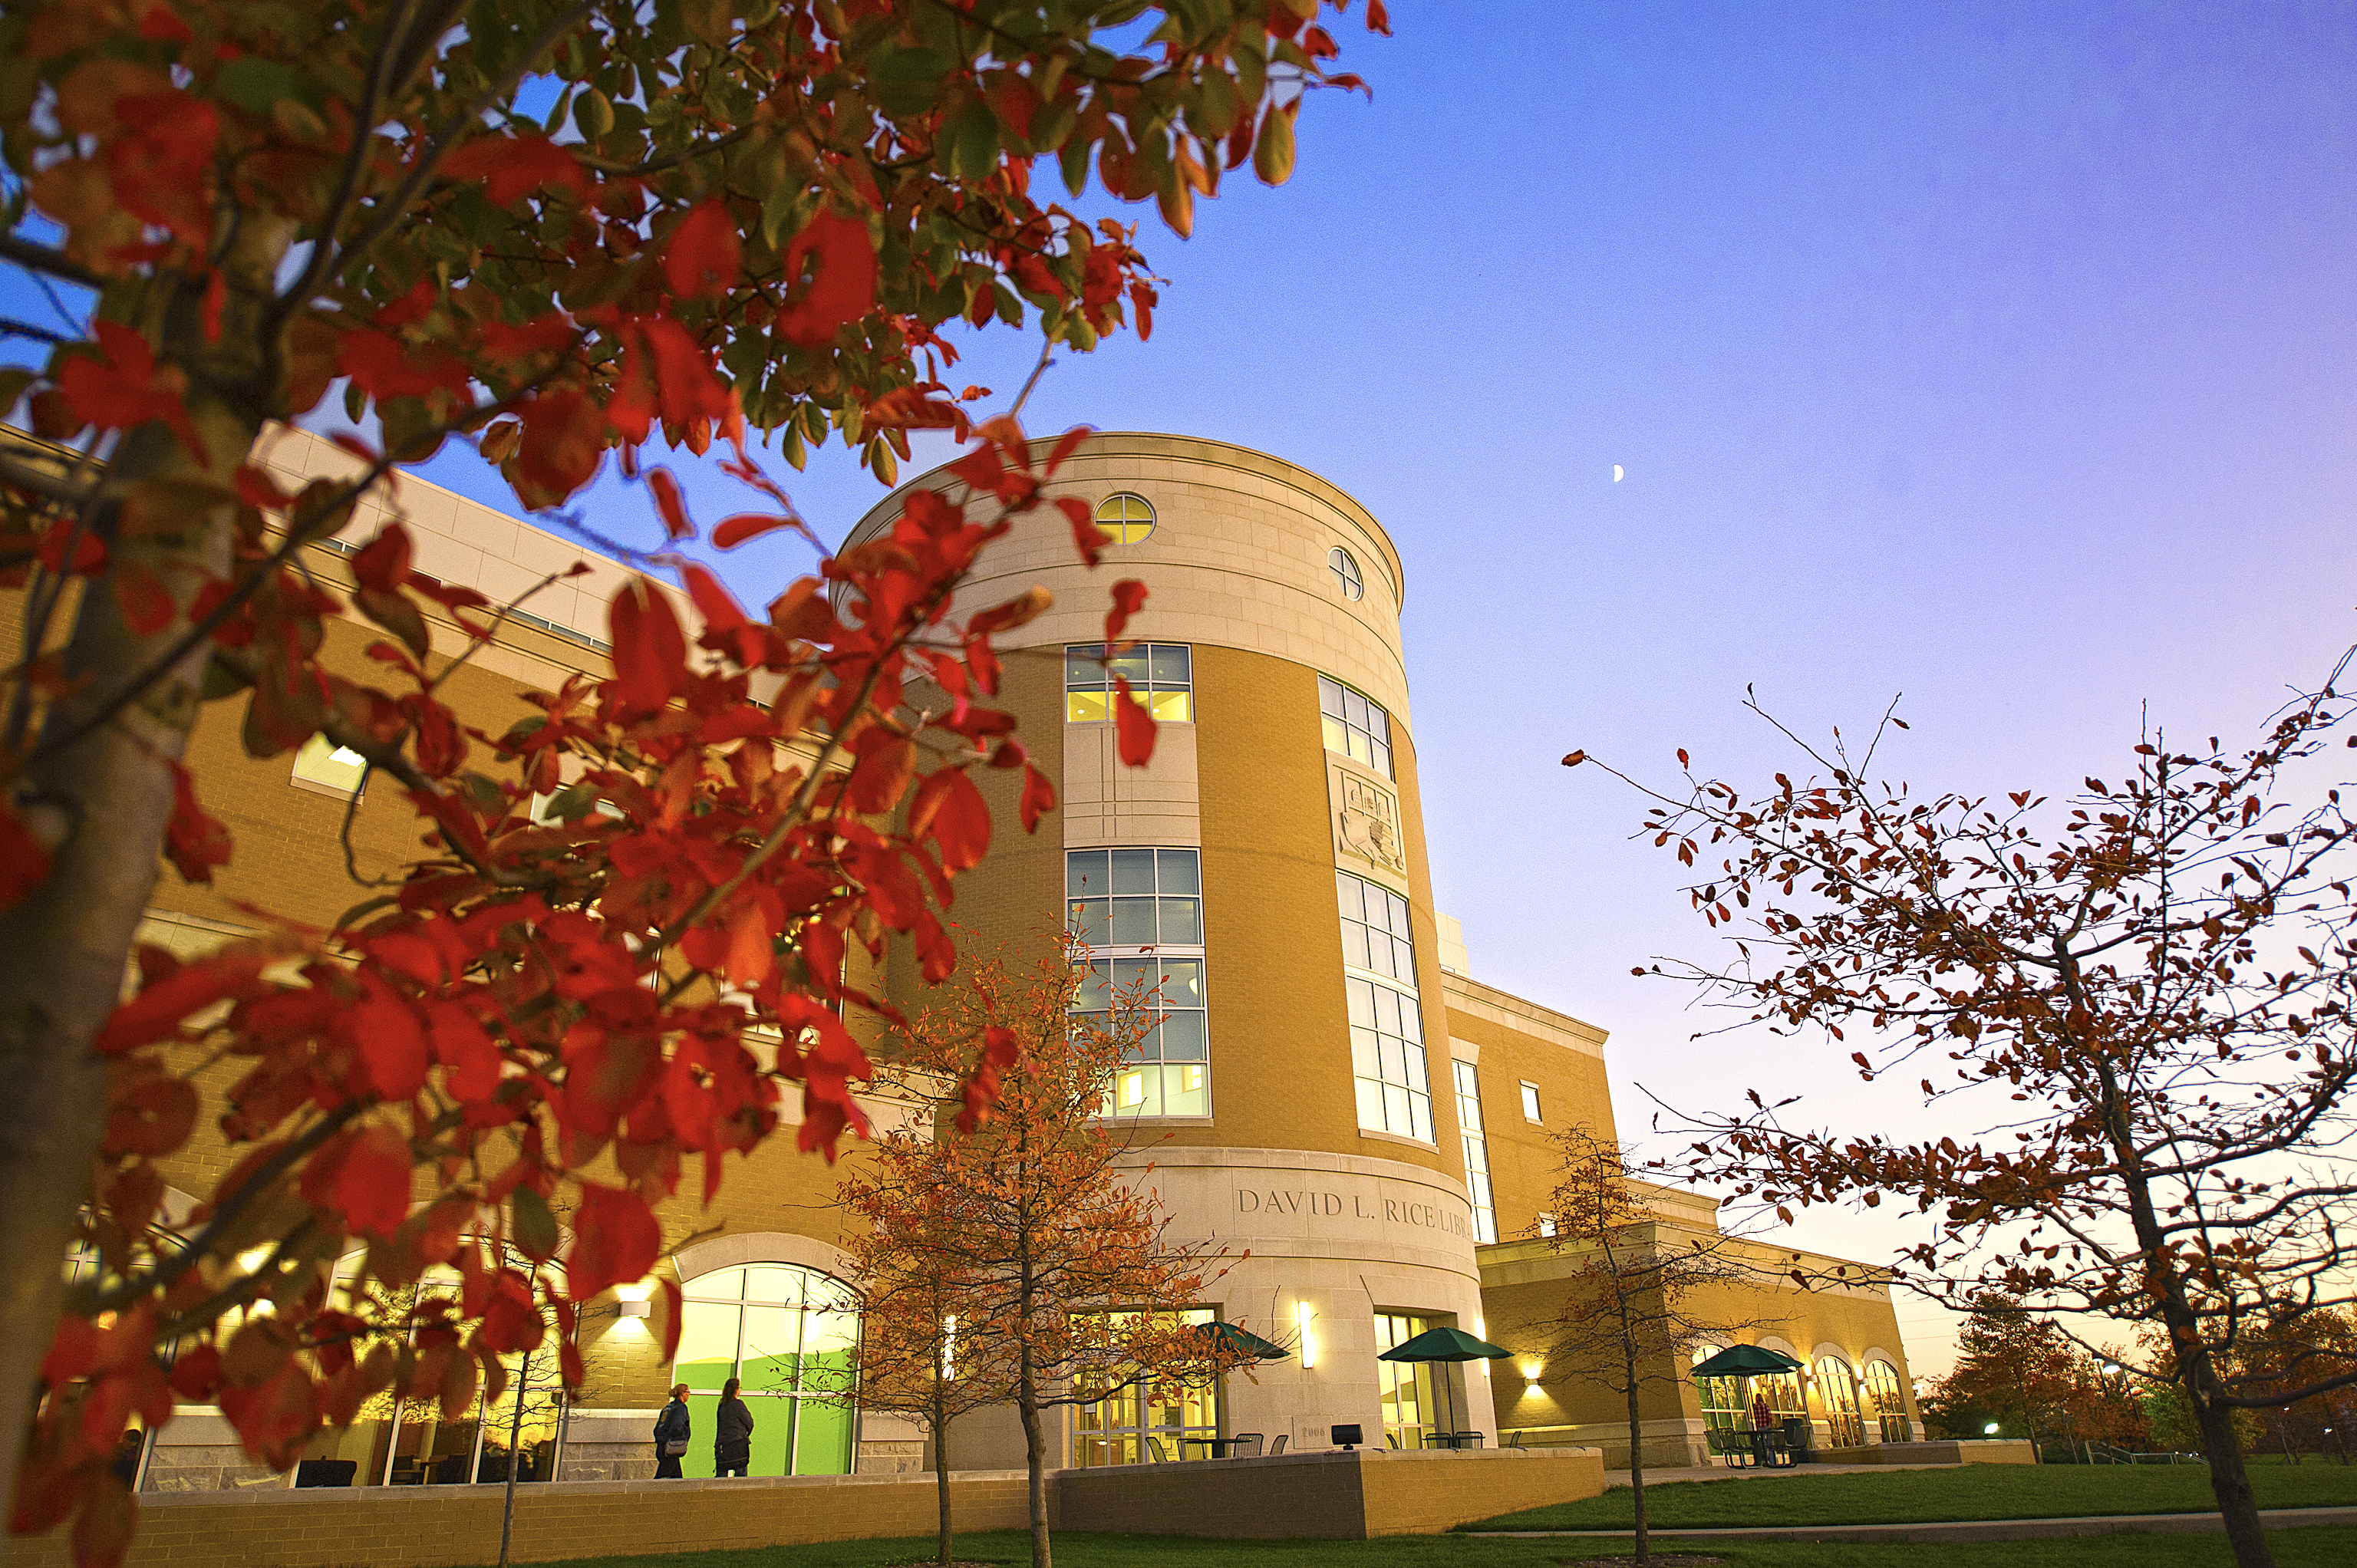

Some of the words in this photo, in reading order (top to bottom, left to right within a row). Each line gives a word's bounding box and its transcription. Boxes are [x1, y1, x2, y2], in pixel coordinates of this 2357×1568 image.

[1238, 1189, 1342, 1216] DAVID
[1355, 1195, 1375, 1220] L.
[1385, 1199, 1435, 1228] RICE
[1302, 1427, 1325, 1437] 2006
